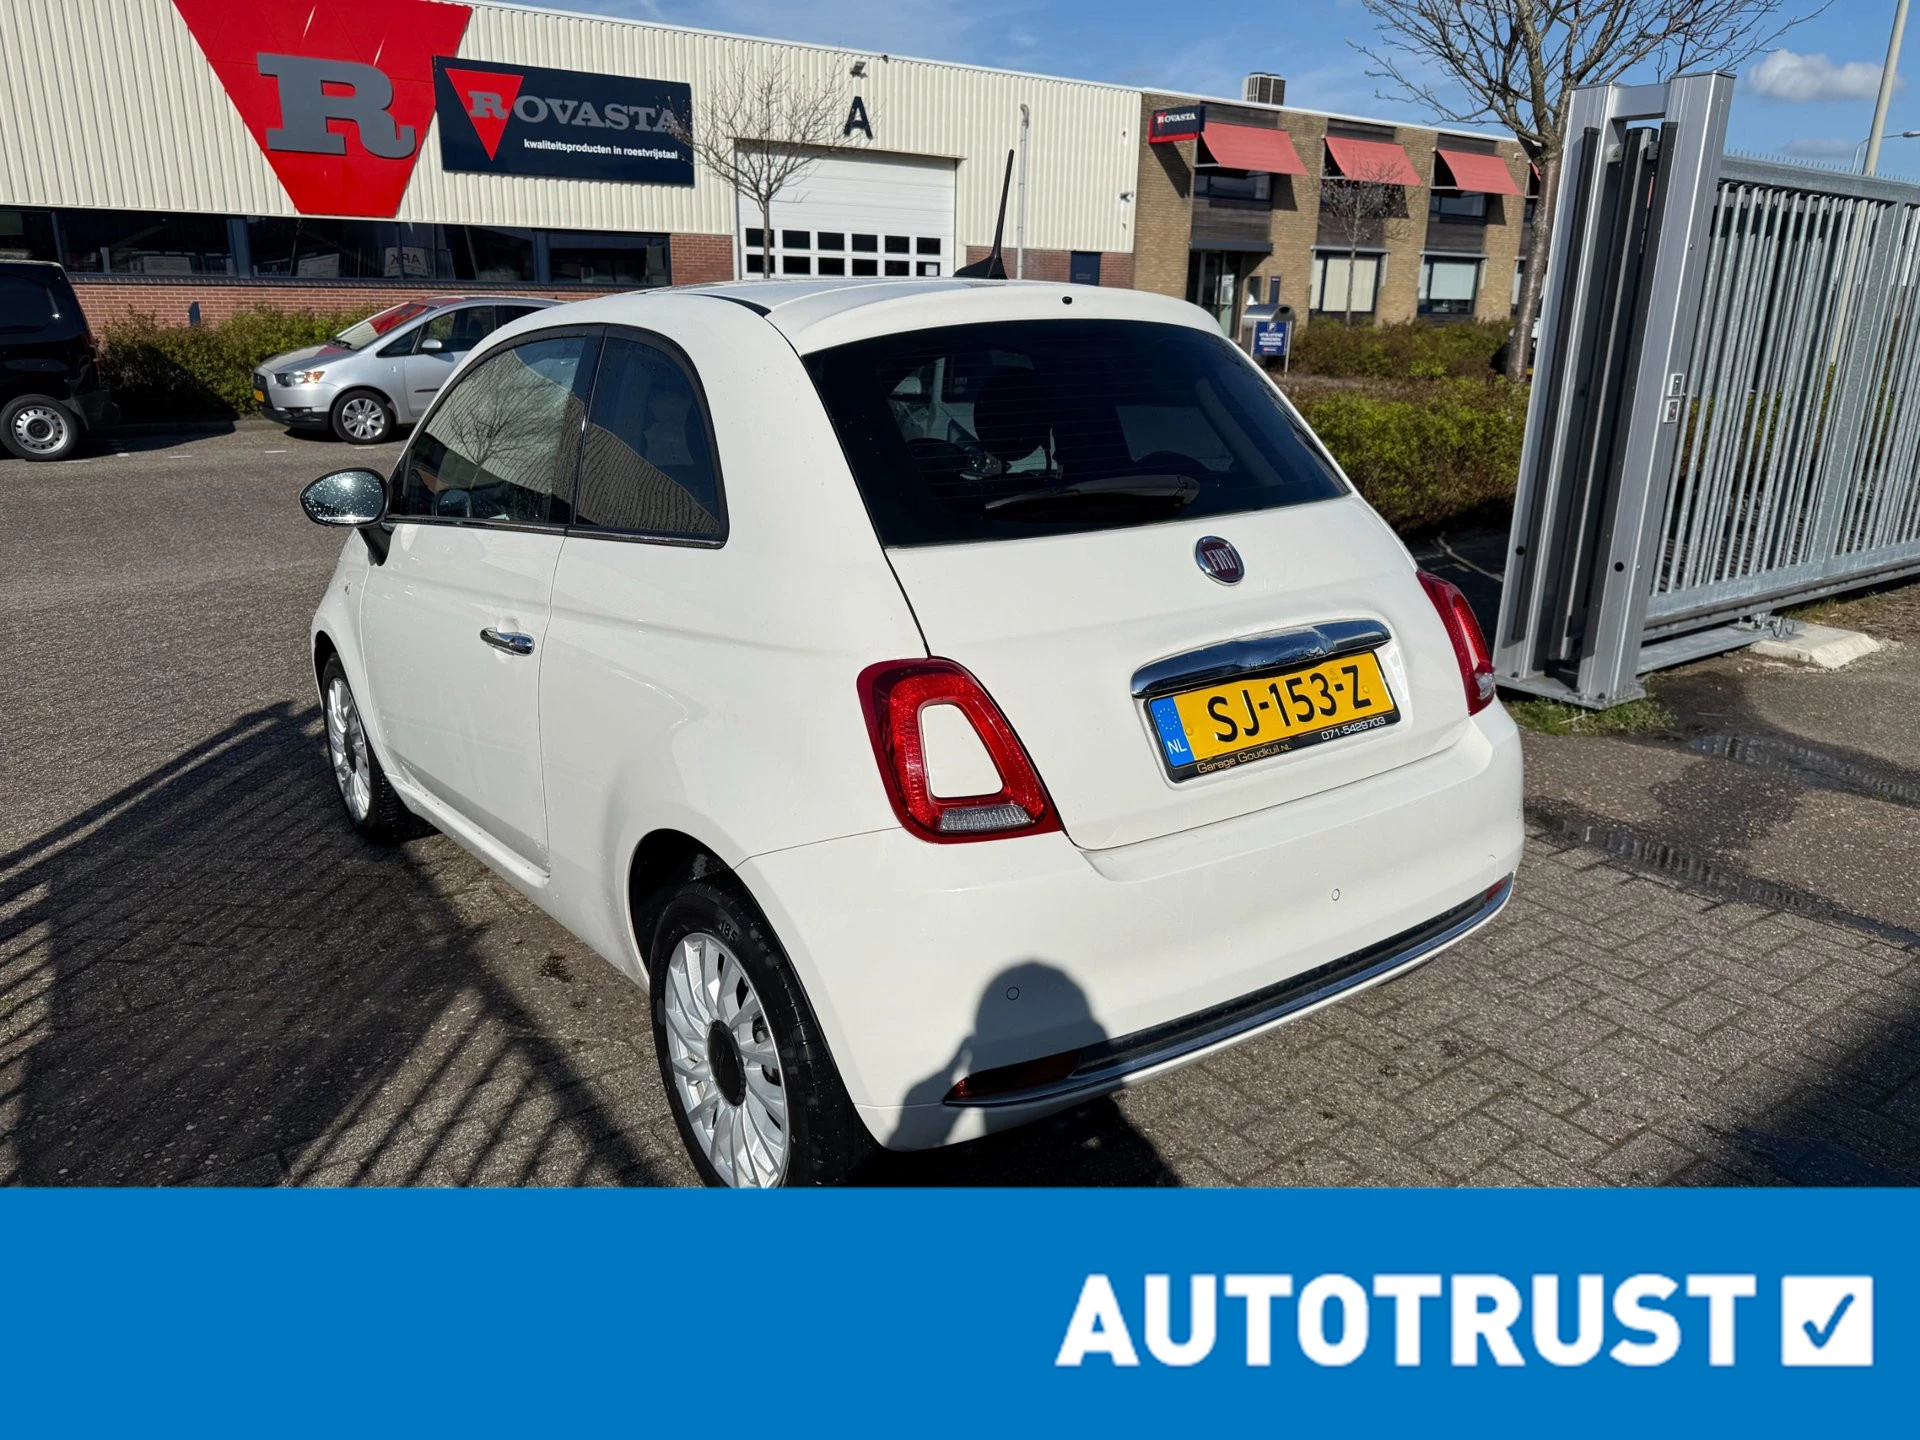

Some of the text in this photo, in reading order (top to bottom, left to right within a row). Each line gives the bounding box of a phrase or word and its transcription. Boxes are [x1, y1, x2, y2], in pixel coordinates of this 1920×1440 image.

[257, 52, 416, 160] R
[843, 96, 873, 139] A
[524, 138, 678, 160] kwaliteitsproducten in roestvrijstaal
[1206, 548, 1236, 571] FIAT
[1207, 665, 1371, 743] SJ-153-Z
[1321, 716, 1386, 740] 071-5429703
[1167, 739, 1188, 755] NL
[1197, 758, 1236, 774] Garage
